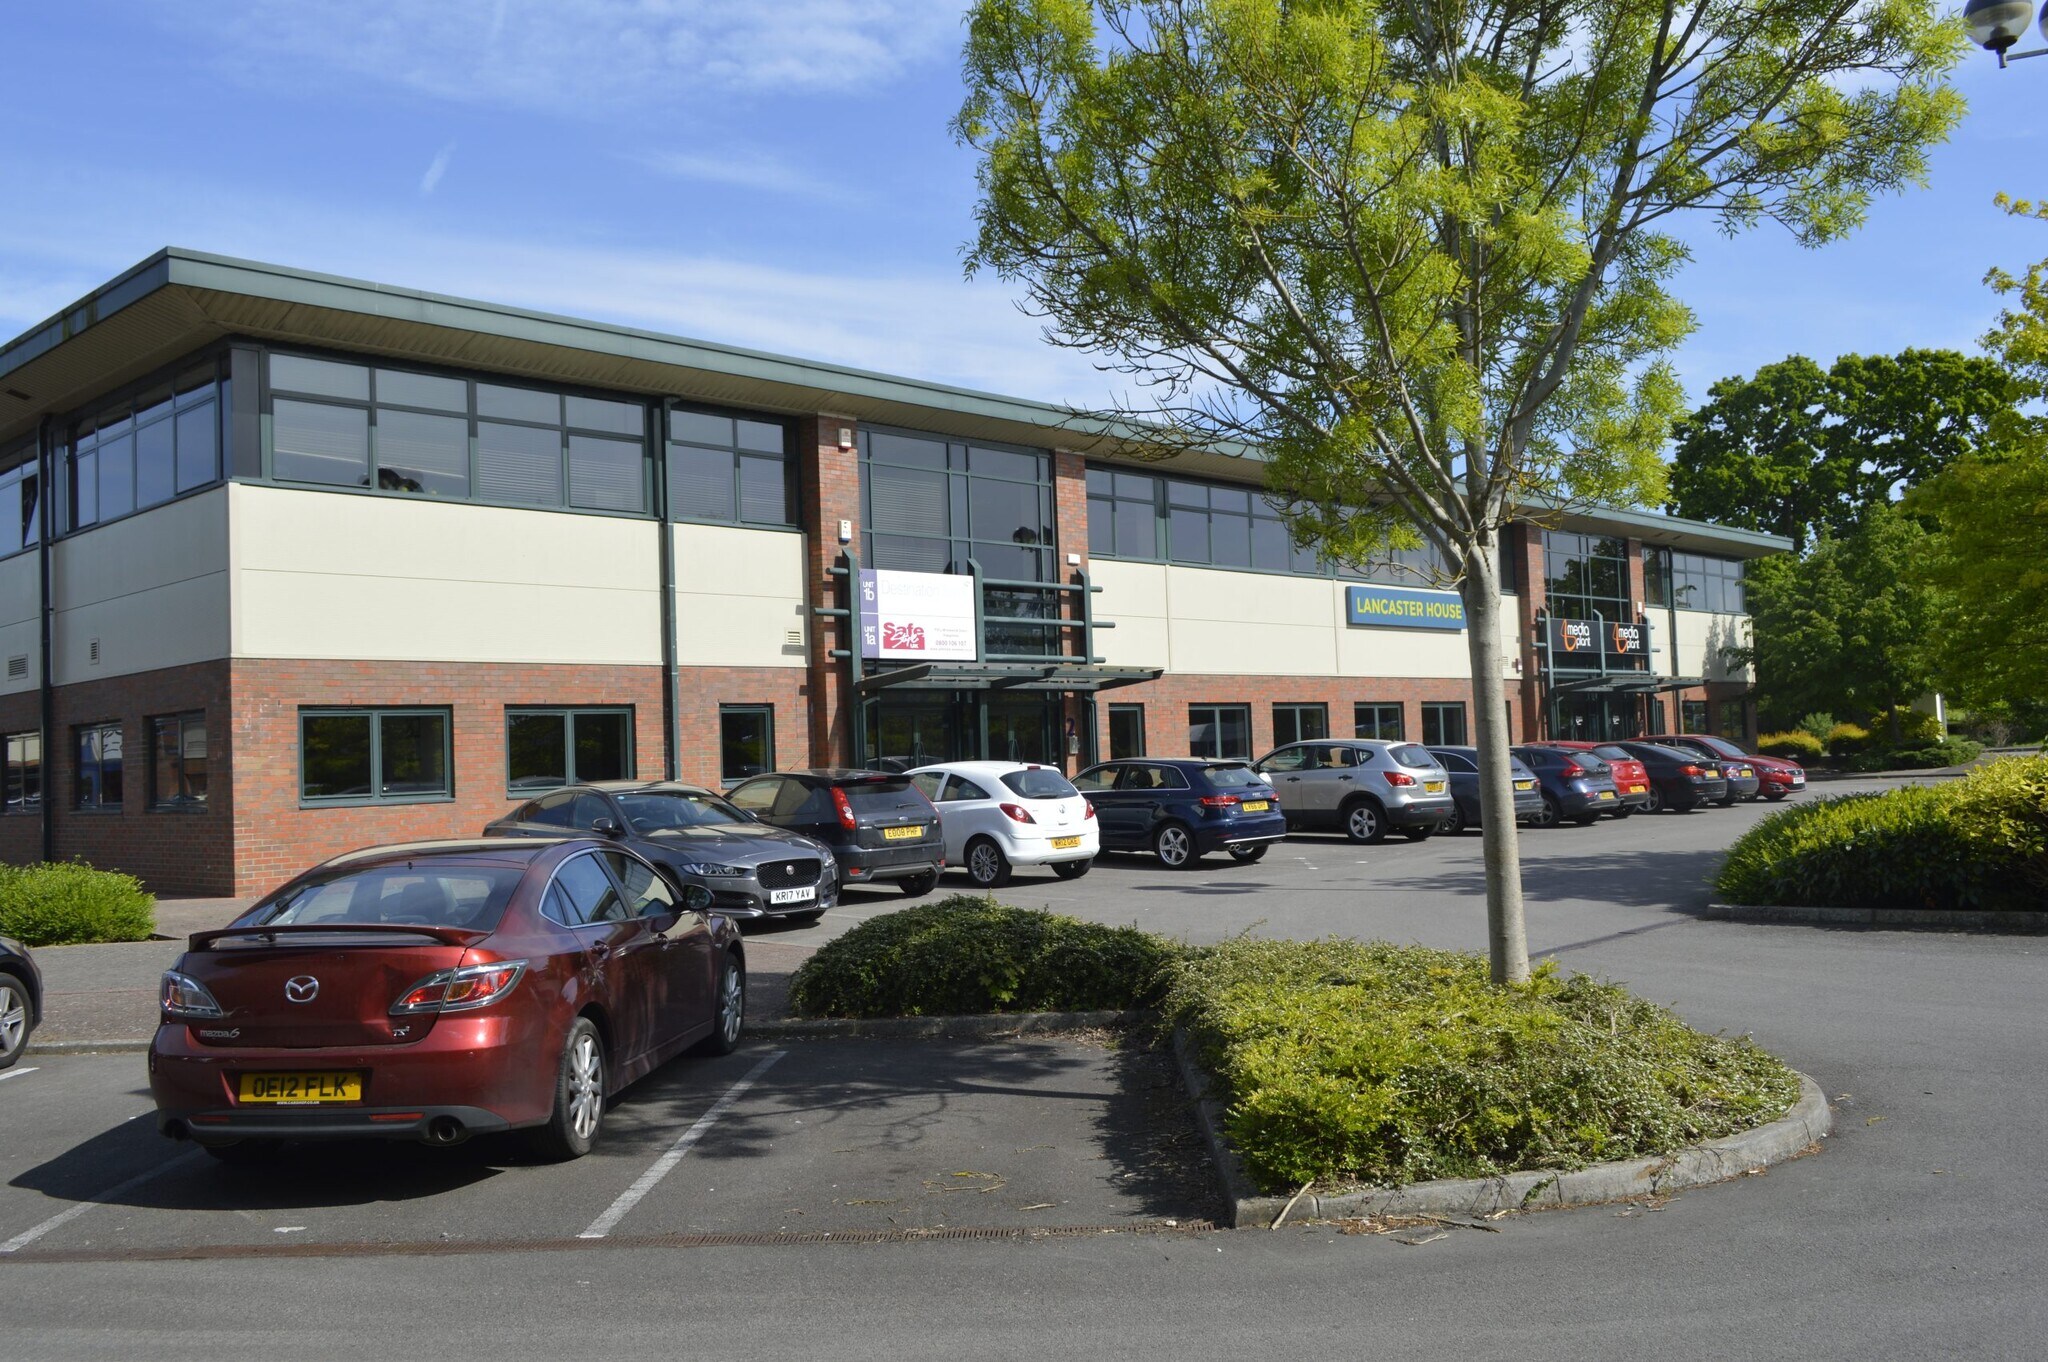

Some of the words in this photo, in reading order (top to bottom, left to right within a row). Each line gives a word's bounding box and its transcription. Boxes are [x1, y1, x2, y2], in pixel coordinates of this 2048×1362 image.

[863, 588, 875, 601] 1b
[1356, 597, 1424, 617] LANCASTER
[1426, 602, 1463, 619] HOUSE
[882, 622, 925, 638] Safe
[1567, 622, 1590, 636] media
[1618, 626, 1639, 639] media
[864, 633, 876, 645] 1a
[1576, 636, 1591, 650] plant
[1626, 639, 1640, 651] plant
[775, 890, 793, 901] KR17
[795, 888, 810, 899] YAV
[252, 1077, 299, 1098] OE12
[304, 1076, 347, 1098] FLK
